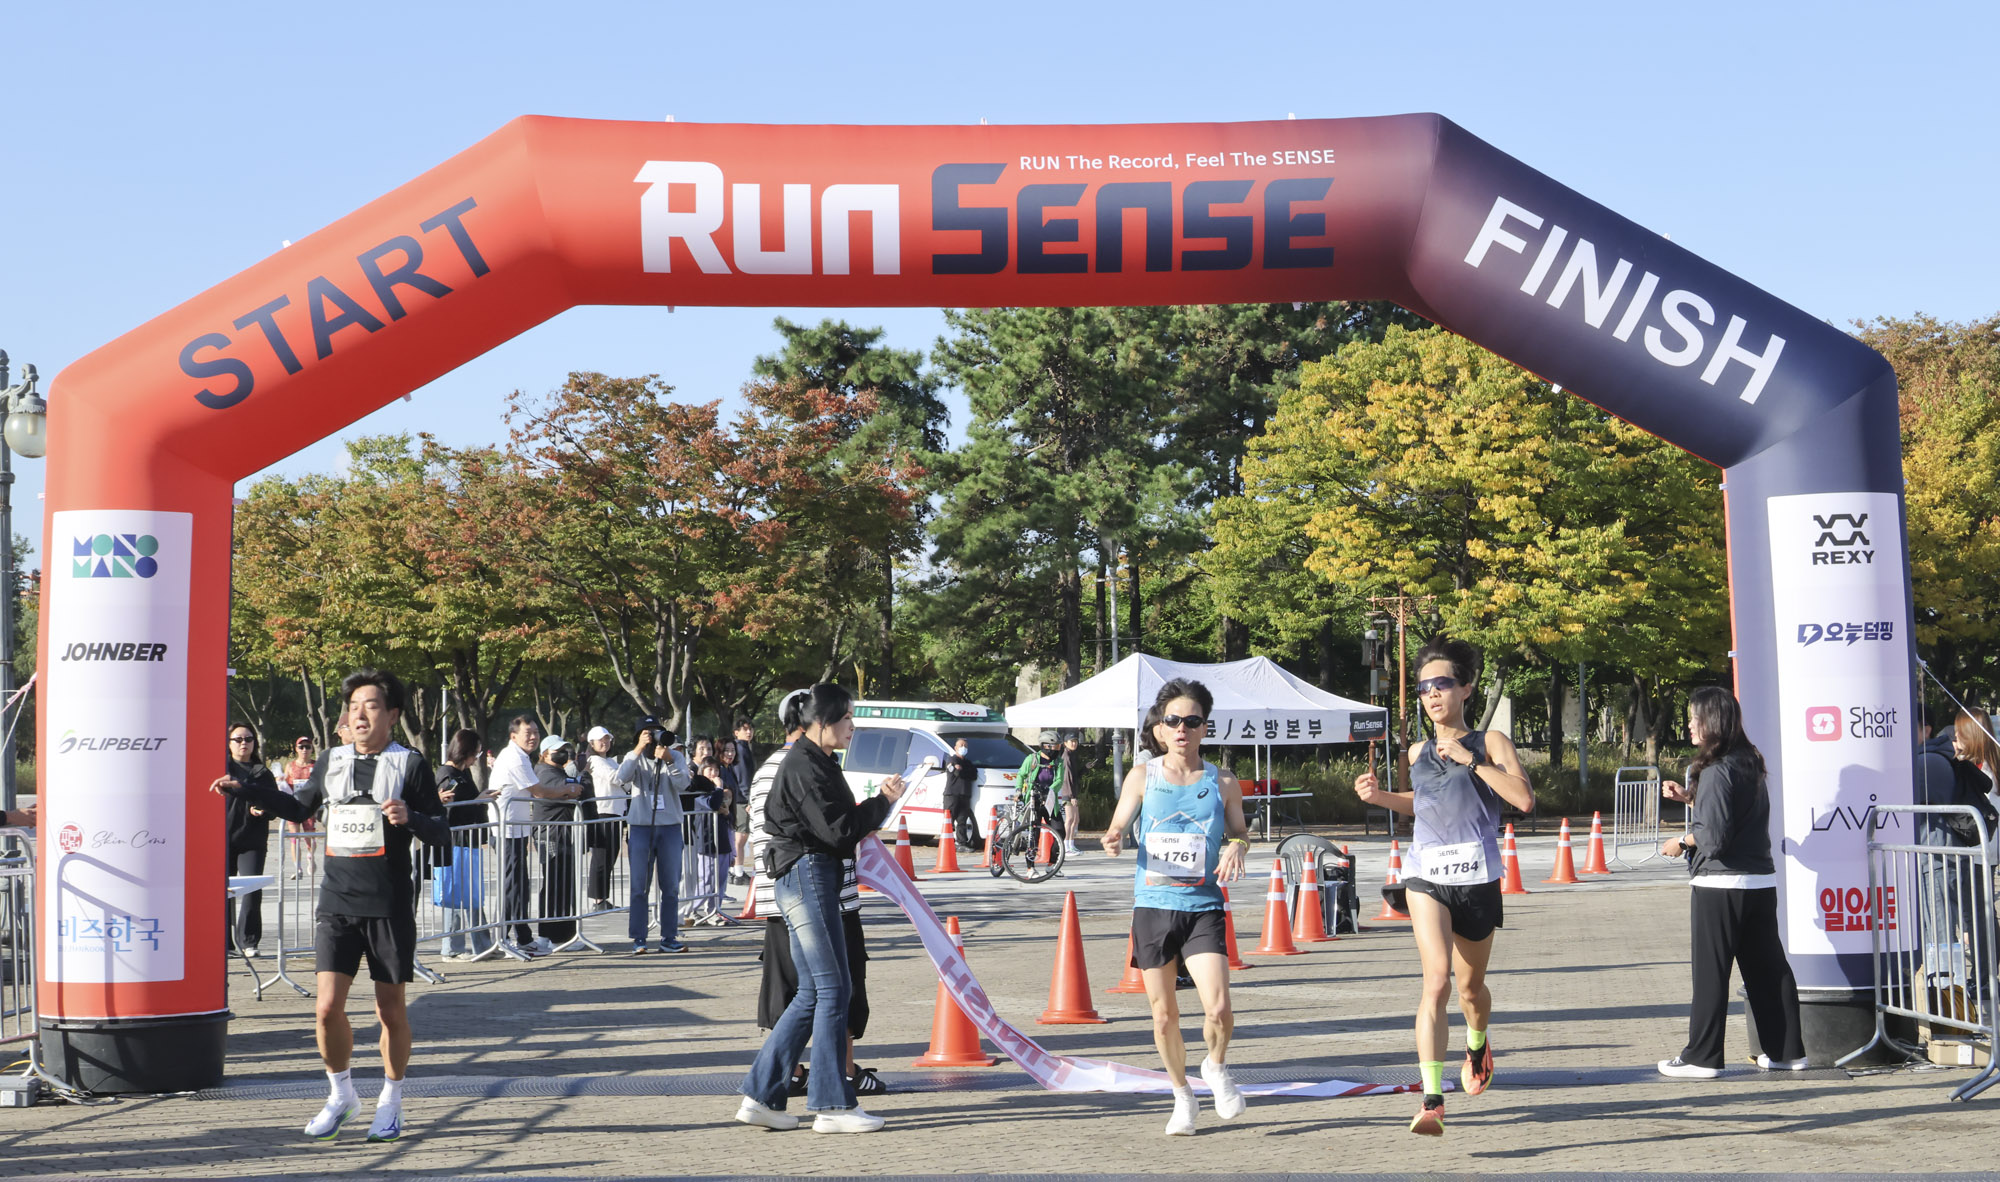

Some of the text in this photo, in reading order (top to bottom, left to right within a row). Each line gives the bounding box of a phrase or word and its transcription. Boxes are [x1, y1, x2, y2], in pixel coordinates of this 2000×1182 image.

[1020, 149, 1335, 170] RUN The Record, Feel The SENSE
[179, 196, 491, 410] START
[1463, 196, 1786, 405] FINISH
[73, 534, 159, 556] MONO
[72, 556, 158, 578] MANO
[1812, 550, 1875, 565] REXY
[1824, 622, 1893, 646] 오늘덤핑
[61, 642, 168, 662] JOHNBER
[1850, 706, 1897, 724] Short
[77, 738, 168, 751] FLIPBELT
[342, 822, 375, 833] 5034
[91, 830, 127, 848] Skin
[1164, 851, 1198, 862] 1761
[1430, 860, 1479, 876] M 1784
[58, 915, 165, 952] 비즈한국
